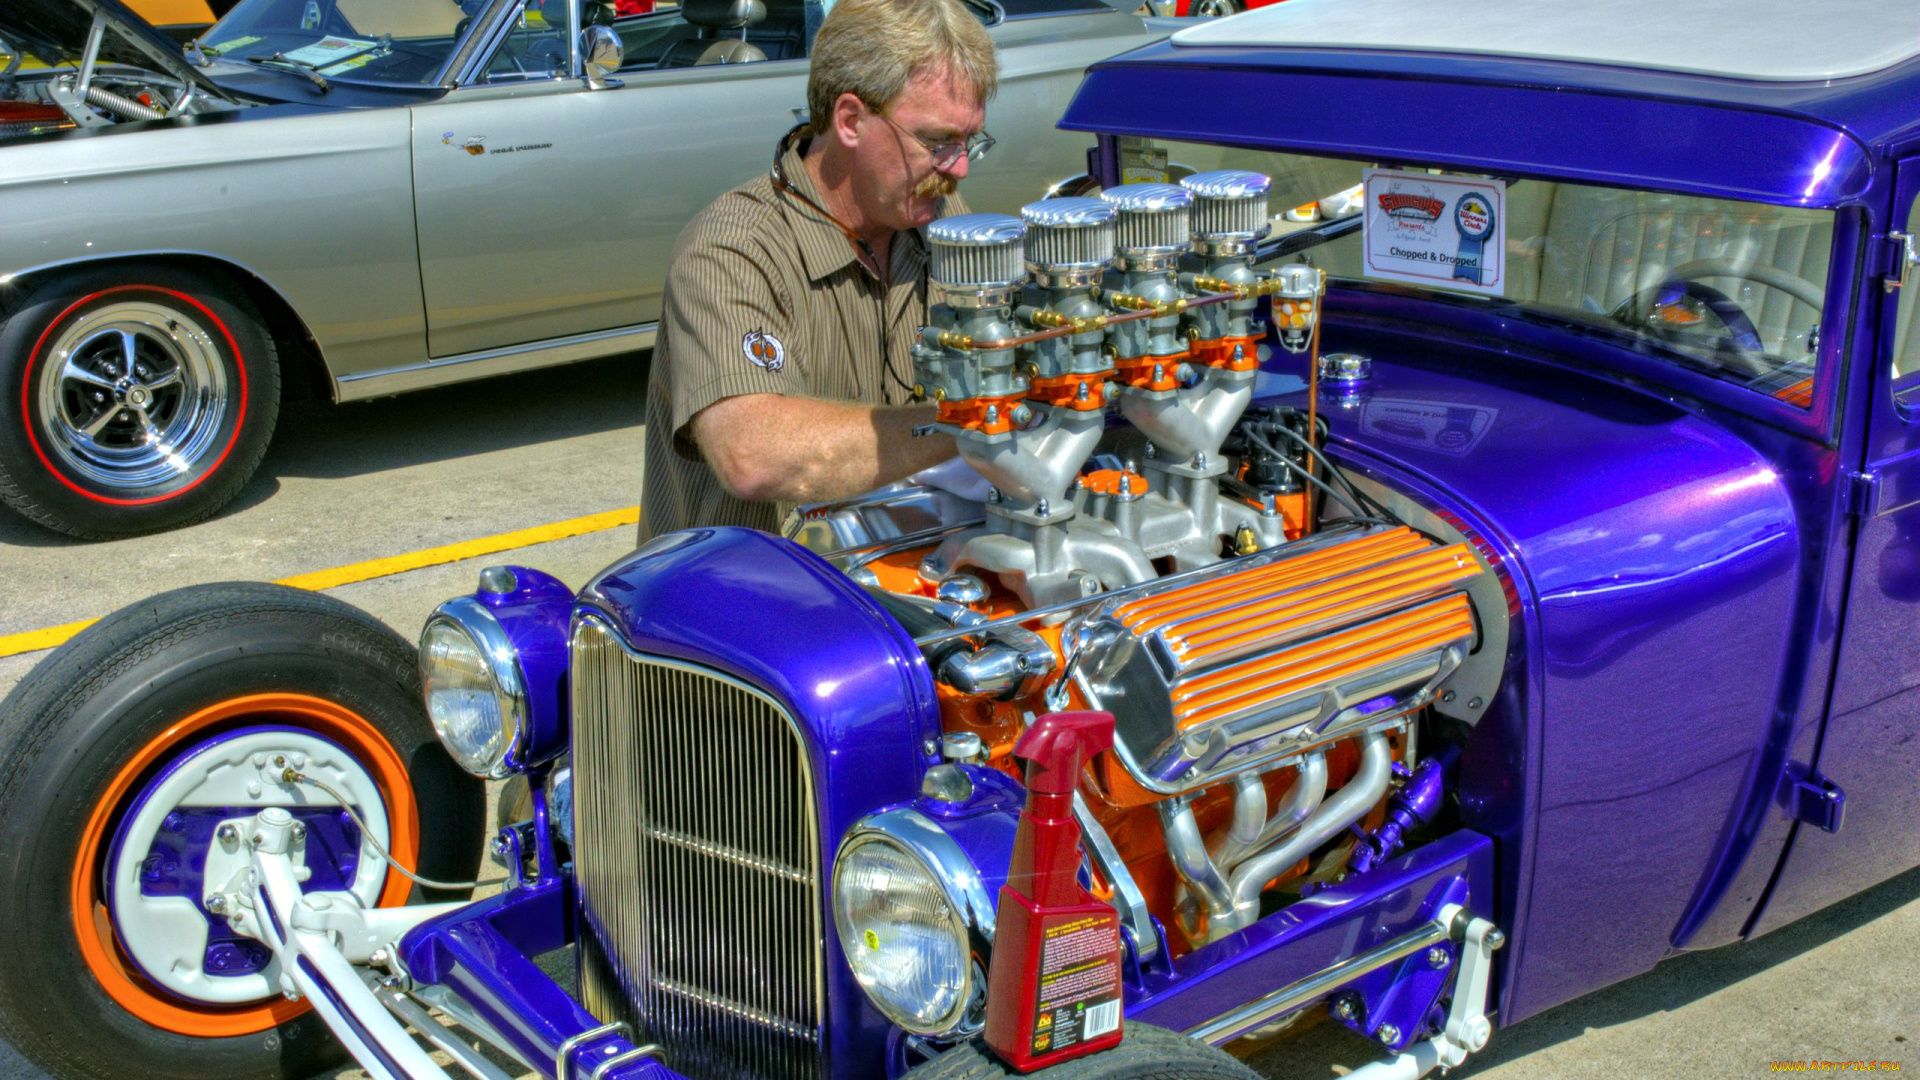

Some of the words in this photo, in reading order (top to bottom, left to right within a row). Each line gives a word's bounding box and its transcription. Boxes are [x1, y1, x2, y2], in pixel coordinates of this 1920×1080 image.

[1460, 210, 1488, 225] Winners
[1463, 220, 1483, 231] Circle
[1390, 246, 1428, 260] Chopped
[1430, 253, 1437, 261] &
[1440, 253, 1477, 267] Dropped
